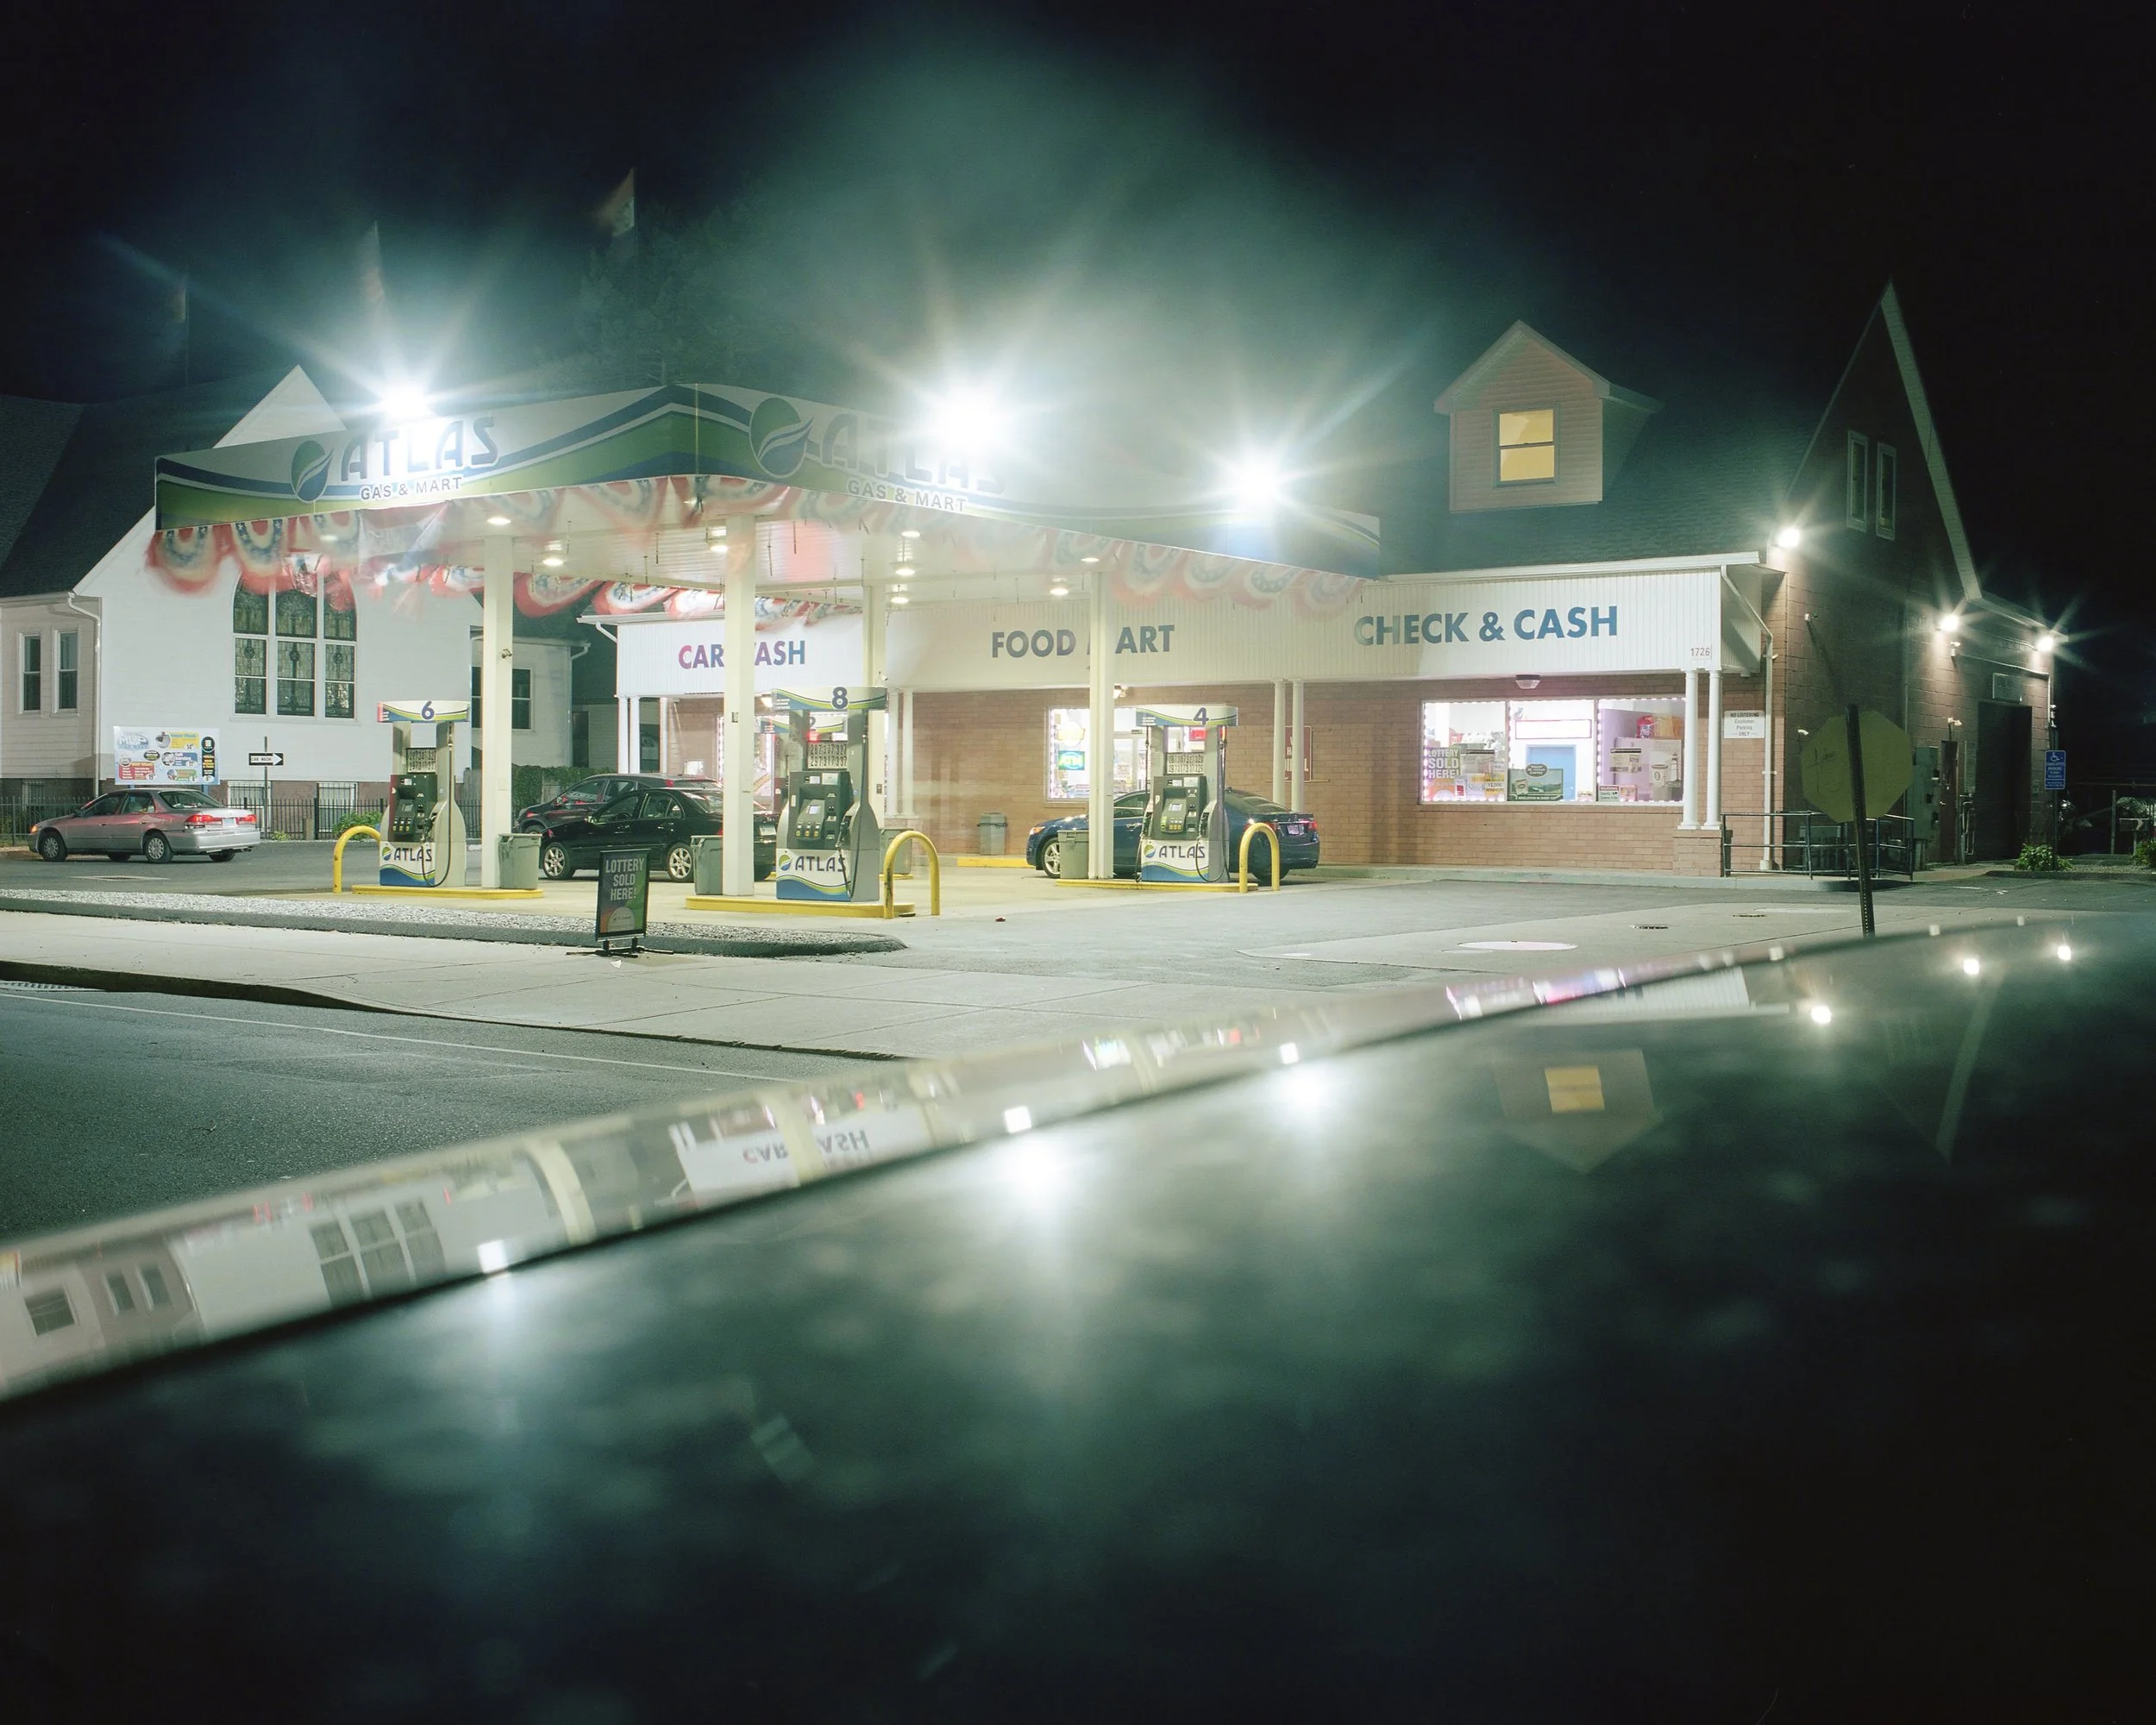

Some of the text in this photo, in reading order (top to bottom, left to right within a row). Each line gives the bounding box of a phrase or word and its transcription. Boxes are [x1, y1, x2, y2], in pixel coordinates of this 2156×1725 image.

[342, 416, 498, 481] ATLAS
[361, 476, 462, 499] GAS & MART
[848, 480, 967, 512] GAS & MART
[1354, 605, 1618, 646] CHECK & CASH
[992, 624, 1175, 658] FOOD ART
[678, 640, 805, 669] CAR ASH
[1690, 648, 1710, 656] 1726
[831, 686, 849, 710] 8
[421, 700, 436, 720] 6
[1193, 706, 1209, 725] 4
[1428, 749, 1458, 757] LOTTERY
[1428, 757, 1459, 768] SOLD
[1428, 768, 1460, 779] HERE!
[393, 846, 432, 862] ATLAS
[1158, 845, 1206, 858] ATLAS
[605, 857, 645, 874] LOTTERY
[795, 856, 846, 872] ATLAS
[613, 873, 636, 887] SOLD
[611, 887, 636, 901] HERE!
